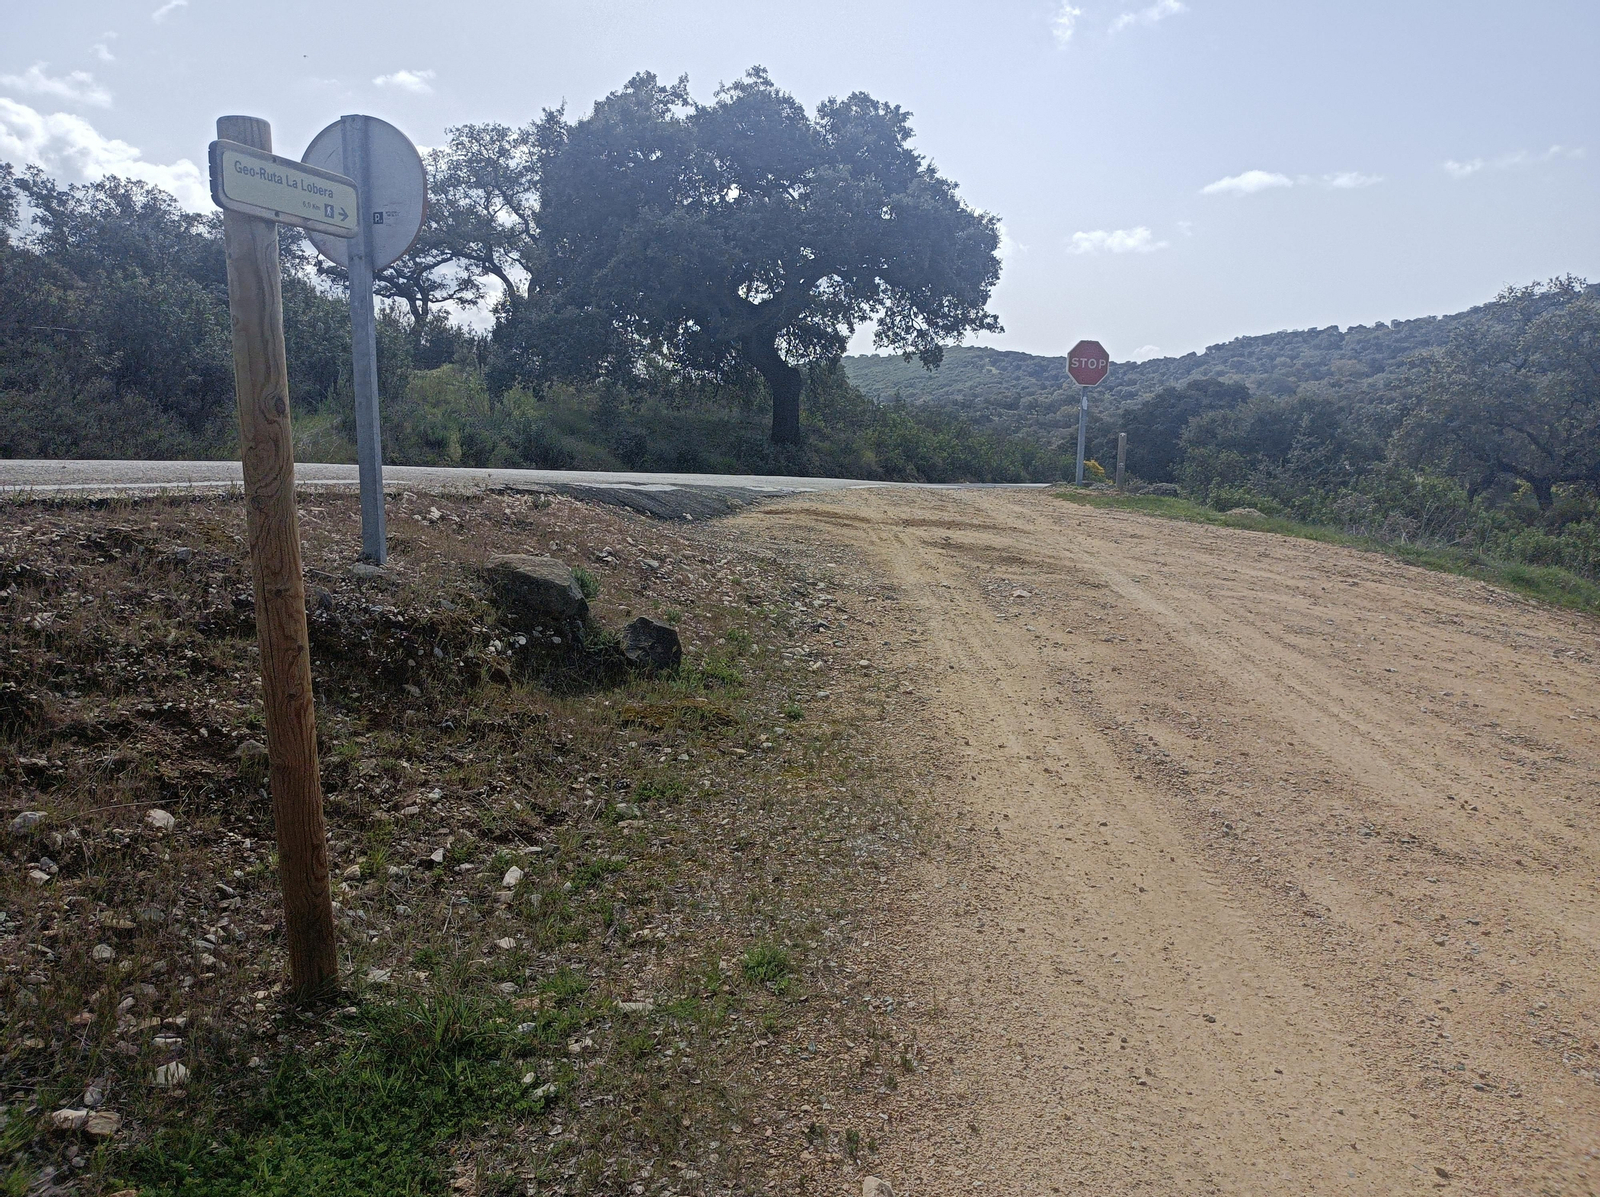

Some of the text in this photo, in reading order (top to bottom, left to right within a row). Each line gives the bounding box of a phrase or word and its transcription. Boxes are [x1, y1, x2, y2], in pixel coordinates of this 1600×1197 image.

[234, 160, 334, 199] Geo-Ruta La Lobera
[1071, 357, 1107, 370] STOP
